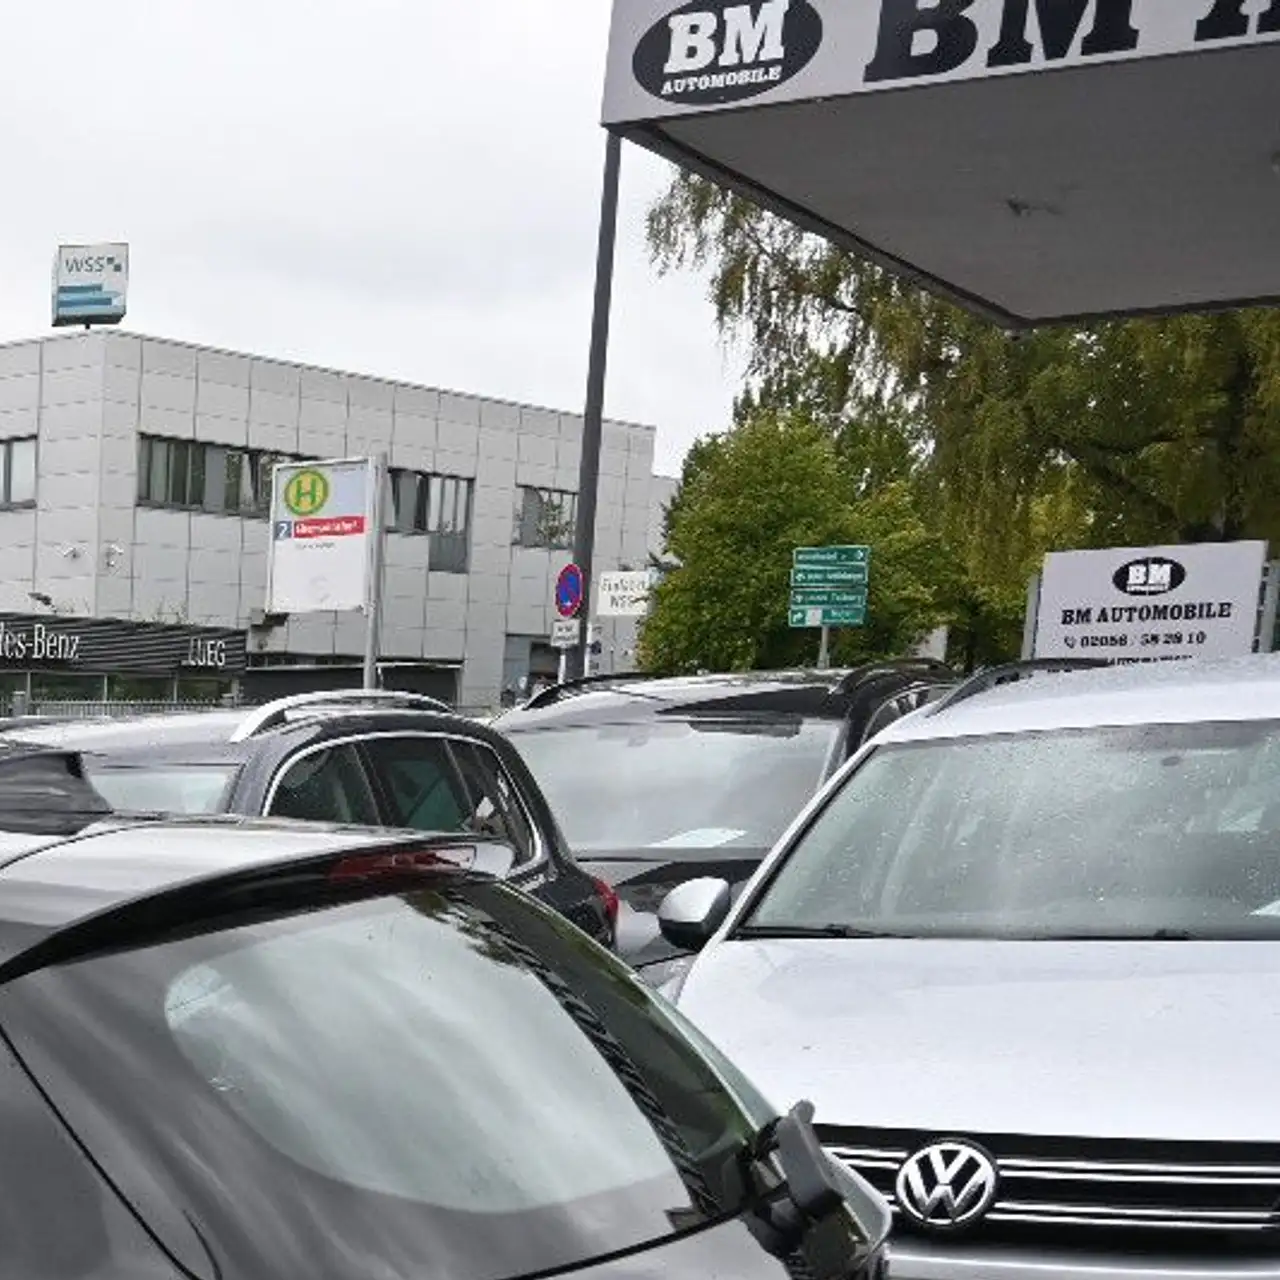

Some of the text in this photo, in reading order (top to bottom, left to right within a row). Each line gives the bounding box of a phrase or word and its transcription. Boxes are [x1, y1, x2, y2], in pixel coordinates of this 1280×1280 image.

[663, 0, 789, 73] BM
[661, 65, 783, 95] AUTOMOBILE
[65, 256, 105, 273] WSS
[296, 478, 317, 508] H
[1127, 564, 1173, 585] BM
[1061, 602, 1233, 625] BM AUTOMOBILE
